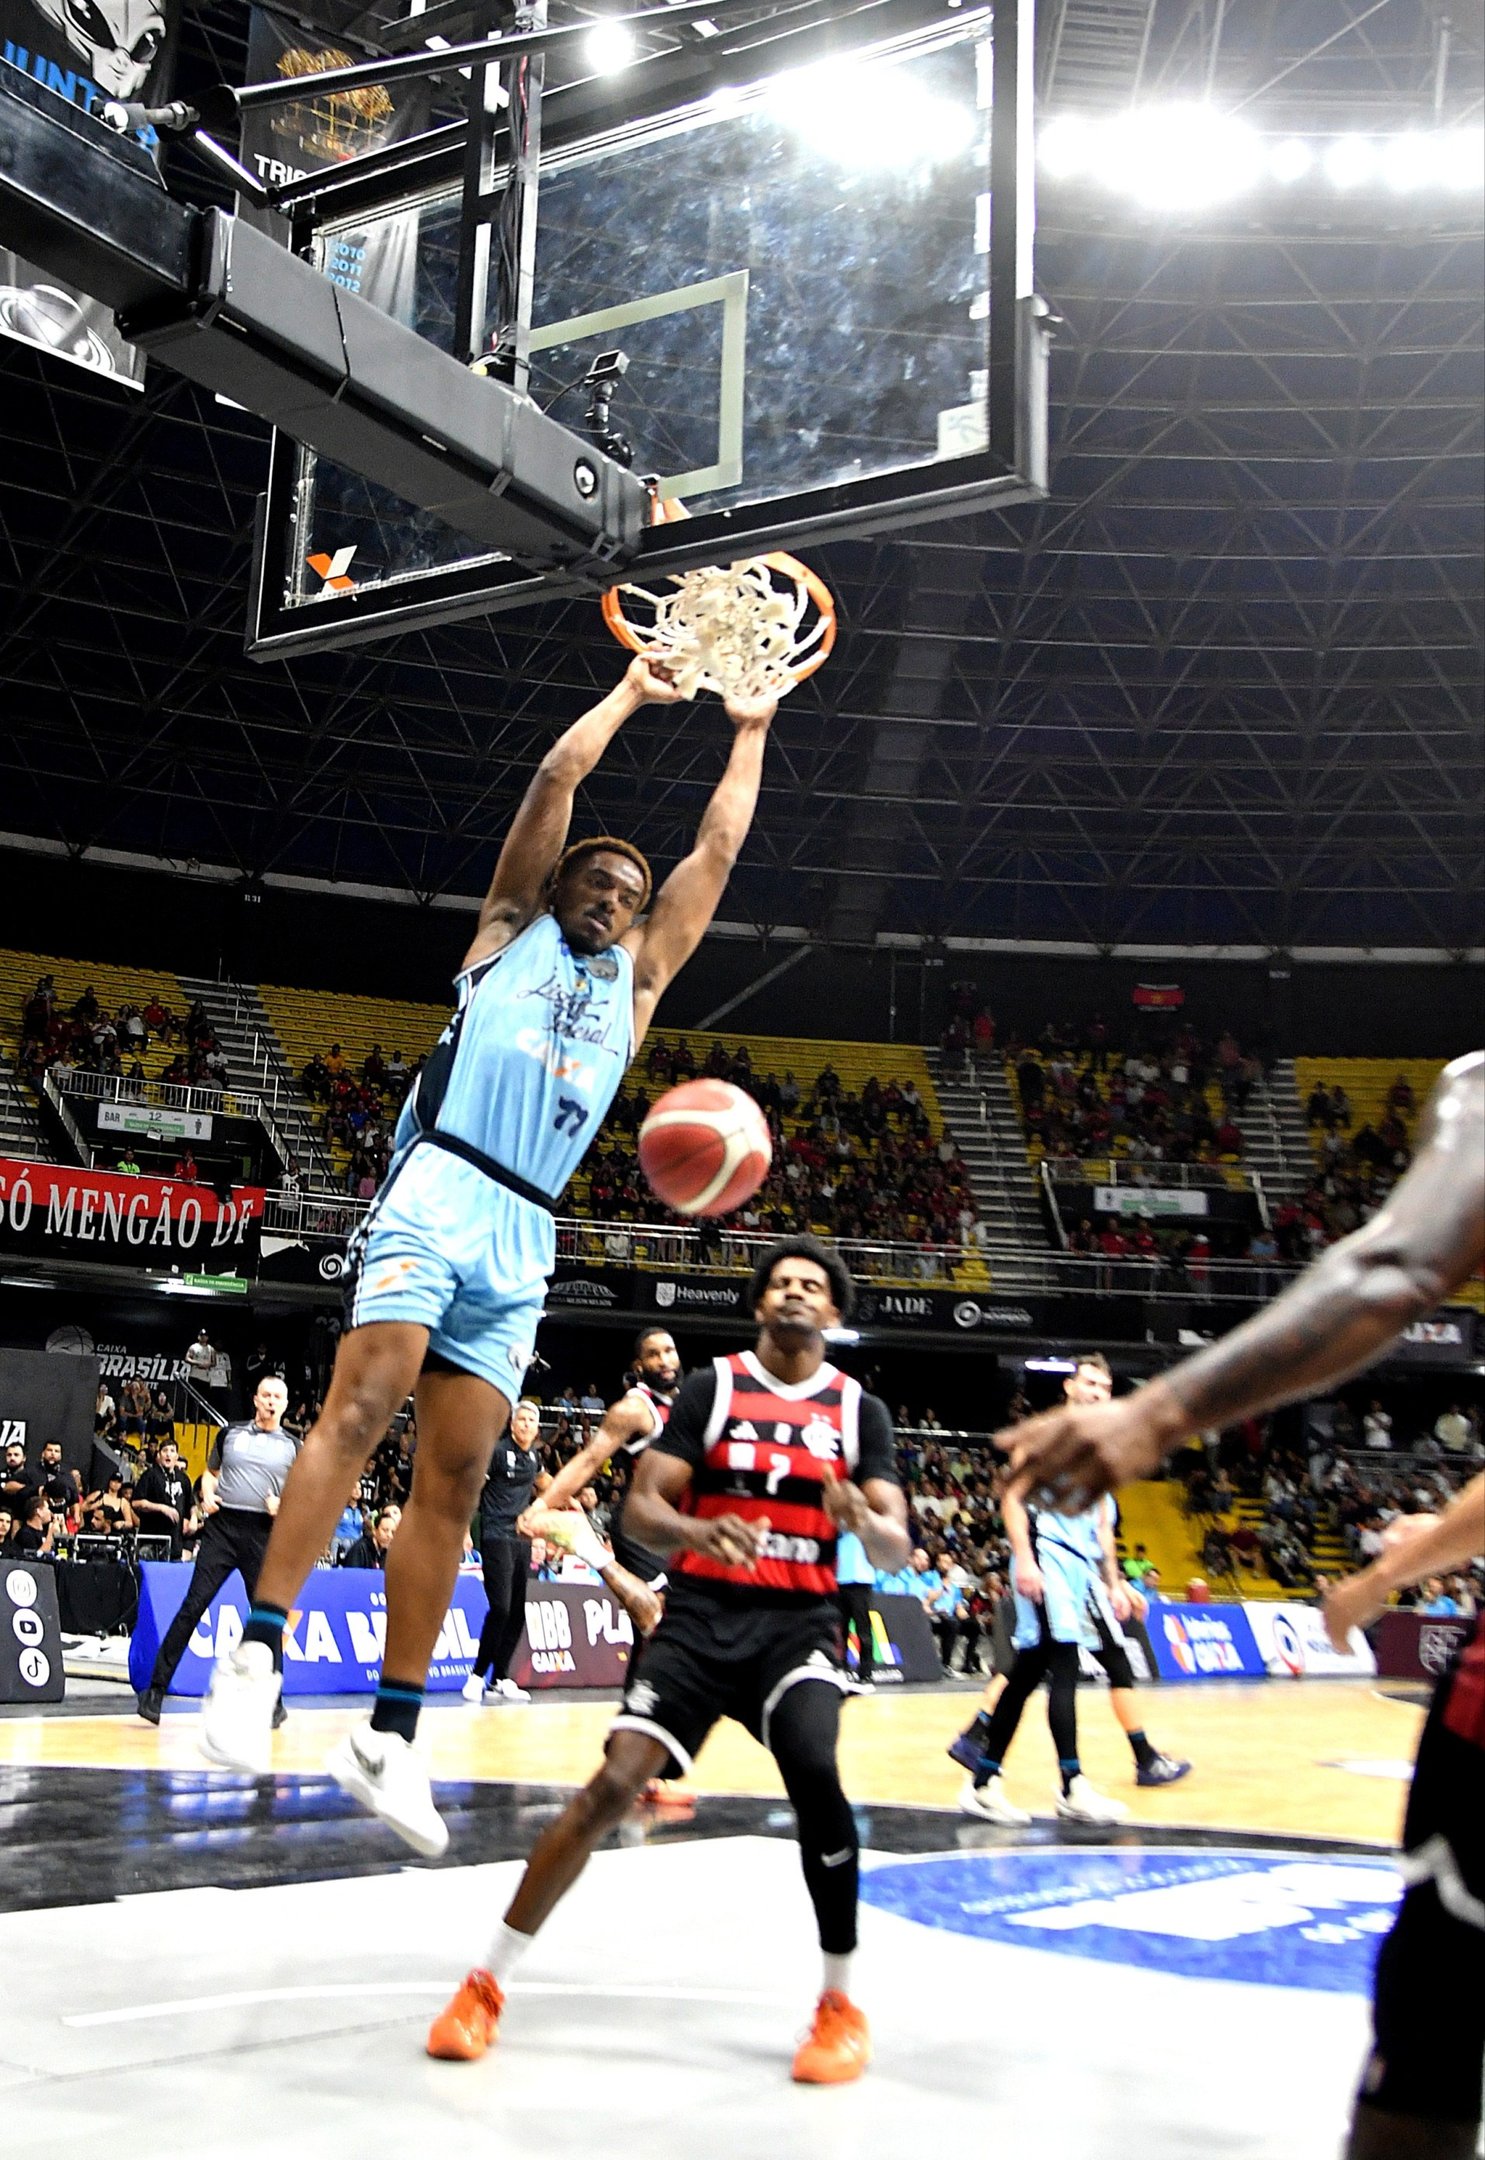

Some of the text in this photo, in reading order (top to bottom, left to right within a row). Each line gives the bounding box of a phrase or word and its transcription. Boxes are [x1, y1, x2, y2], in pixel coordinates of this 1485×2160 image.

[104, 1111, 162, 1122] BAR 12
[0, 1168, 33, 1232] Ó
[45, 1184, 201, 1248] MENGÃO
[677, 1285, 740, 1305] Heavenly
[96, 1344, 127, 1354] CAIXA
[96, 1353, 192, 1383] BRASÍLIA
[766, 1453, 791, 1496] 7
[524, 1600, 573, 1651] NBB
[531, 1650, 576, 1673] CAIXA
